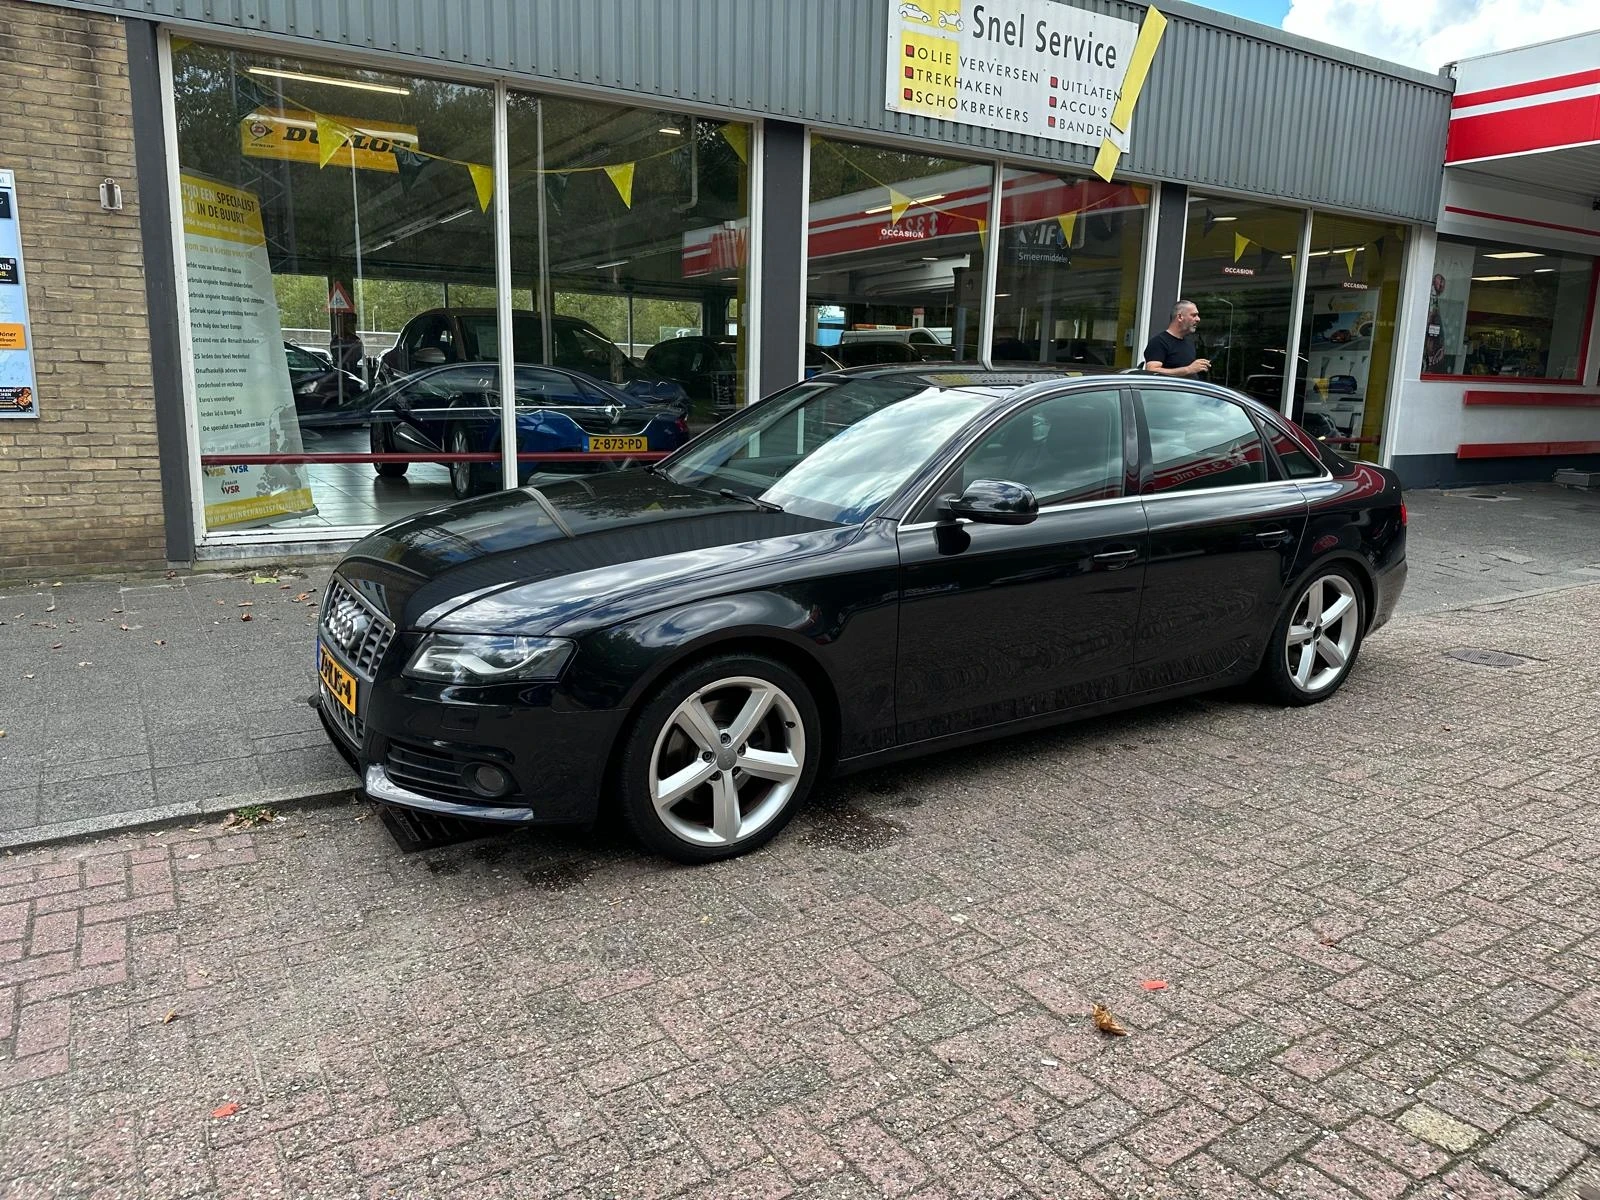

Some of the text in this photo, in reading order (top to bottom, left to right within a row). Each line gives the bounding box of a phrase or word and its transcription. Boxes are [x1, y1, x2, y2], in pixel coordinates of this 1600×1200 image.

[972, 4, 1117, 69] Snel Service
[917, 47, 1040, 84] OLIE VERVERSEN
[916, 69, 1003, 97] TREKHAKEN
[1061, 78, 1123, 102] UITLATEN
[915, 90, 1029, 123] SCHOKBREKERS
[1060, 99, 1108, 119] ACCU'S
[1059, 118, 1112, 138] BANDEN
[216, 191, 255, 212] SPECIALIST
[196, 202, 206, 216] IN
[208, 205, 219, 219] DE
[220, 209, 244, 224] BUURT
[880, 228, 924, 239] OCCASION
[1224, 267, 1254, 275] OCCASION
[1343, 282, 1368, 290] OCCASION
[593, 440, 642, 450] Z-873-PD
[232, 465, 249, 474] VSR
[224, 485, 240, 494] VSR
